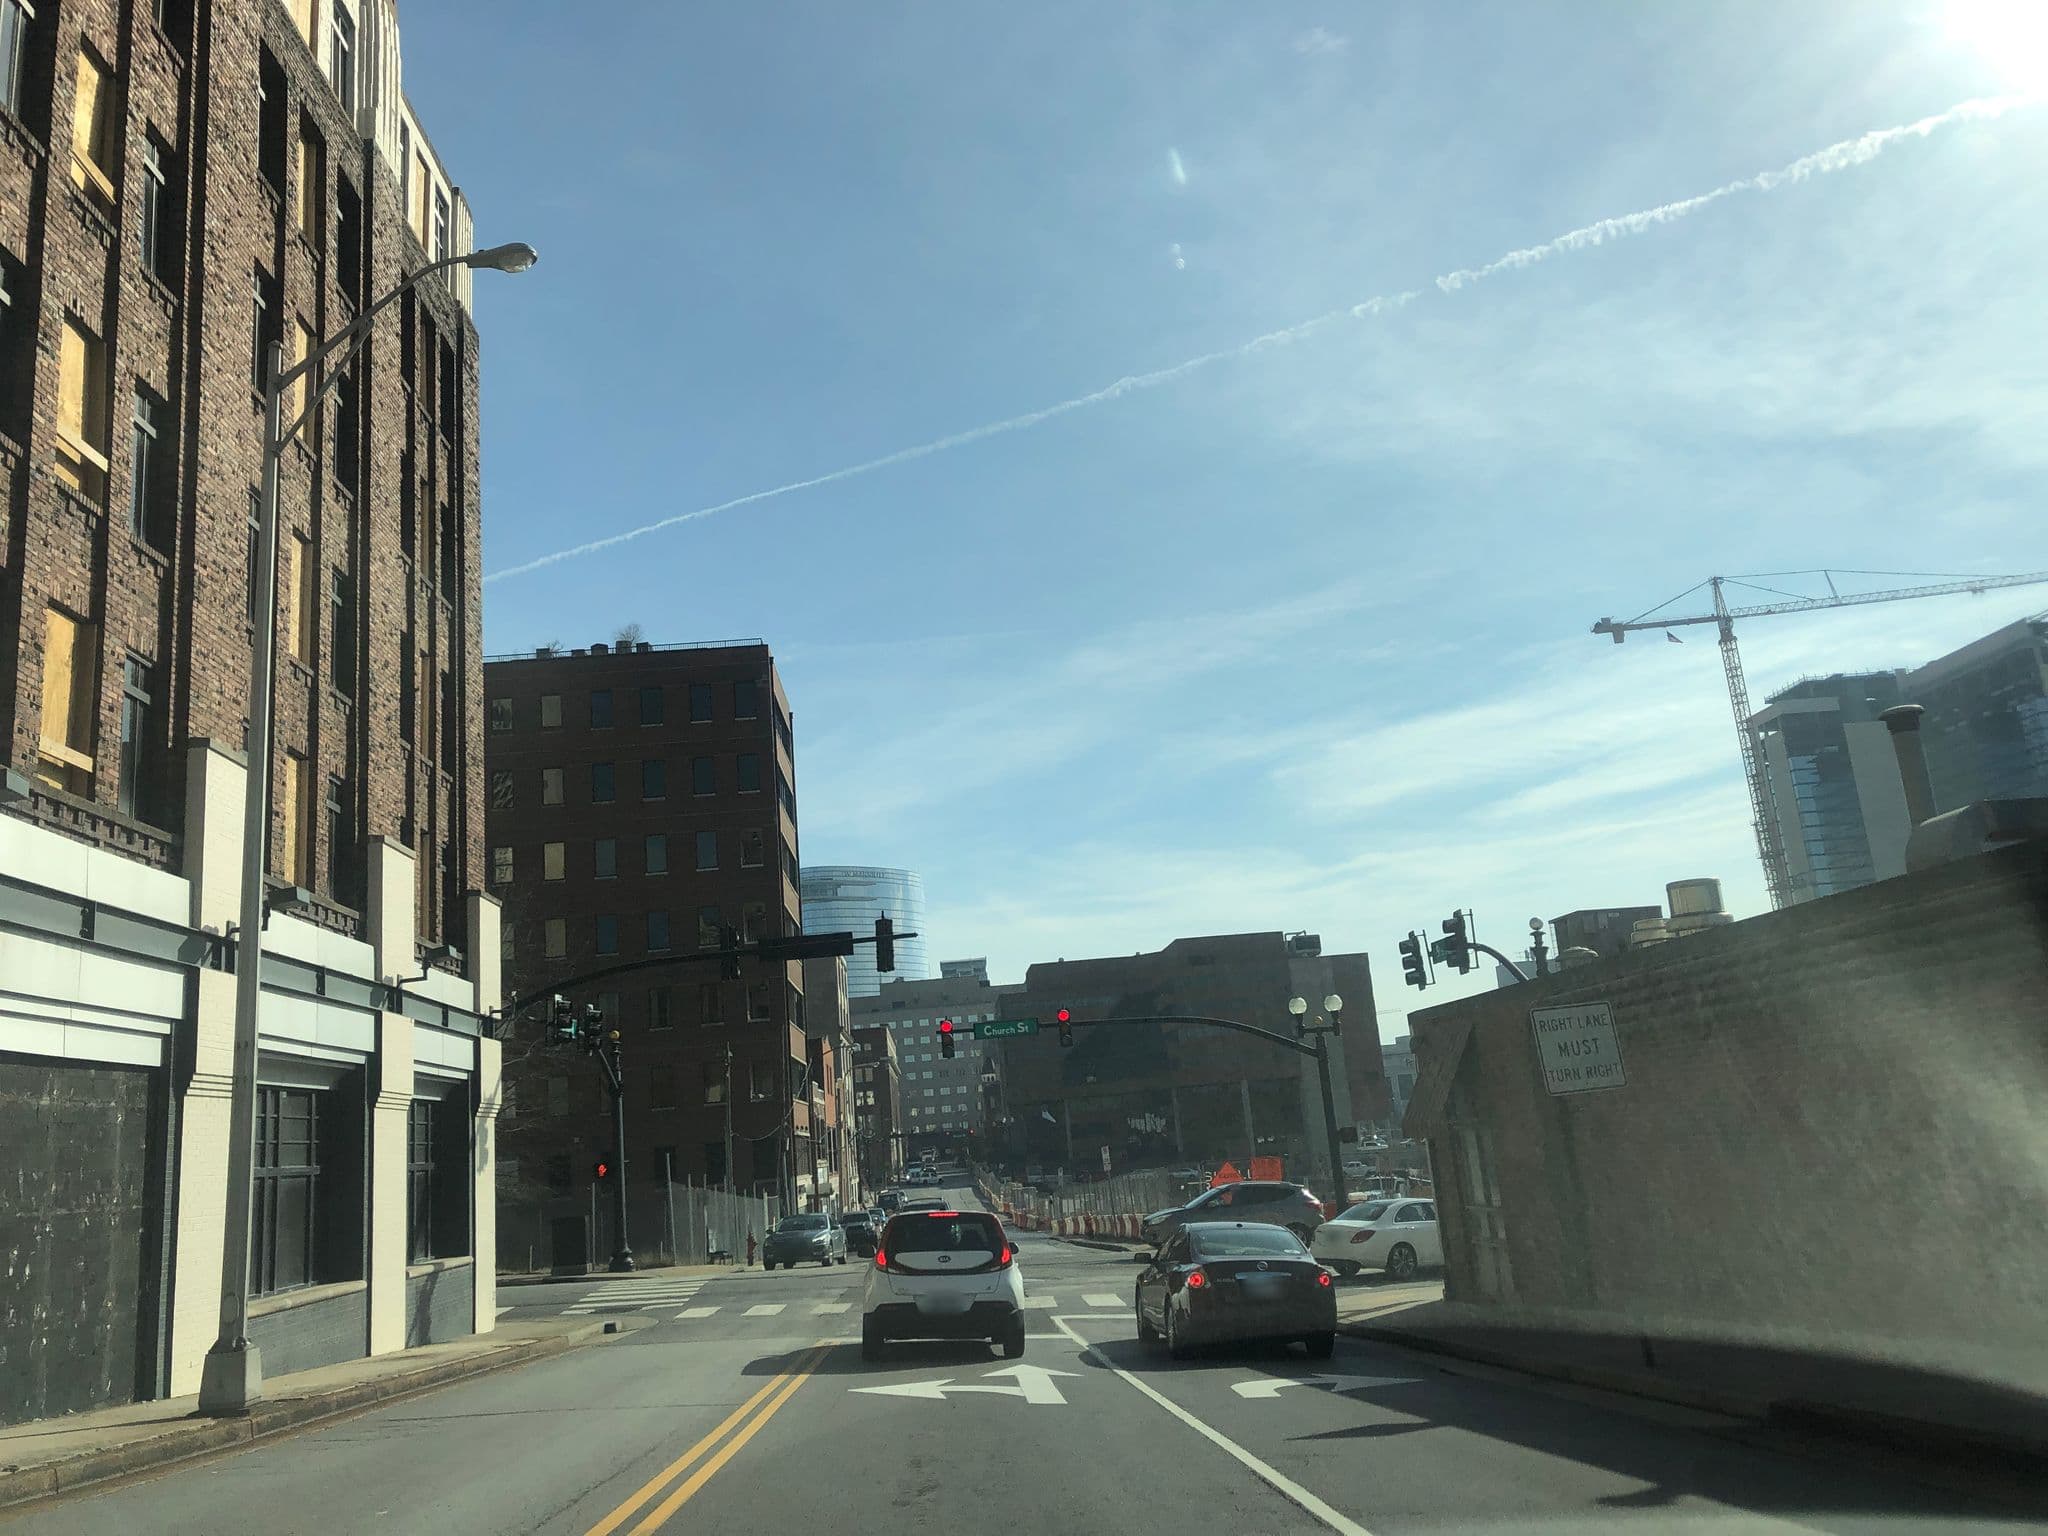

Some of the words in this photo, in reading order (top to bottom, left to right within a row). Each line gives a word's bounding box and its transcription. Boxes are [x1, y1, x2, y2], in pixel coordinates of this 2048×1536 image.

[984, 1025, 1015, 1036] Church
[1017, 1022, 1028, 1033] St
[1538, 1017, 1572, 1032] RIGHT
[1577, 1013, 1608, 1029] LANE
[1557, 1038, 1599, 1057] MUST
[1549, 1067, 1581, 1082] TURN
[1585, 1062, 1619, 1079] RIGHT
